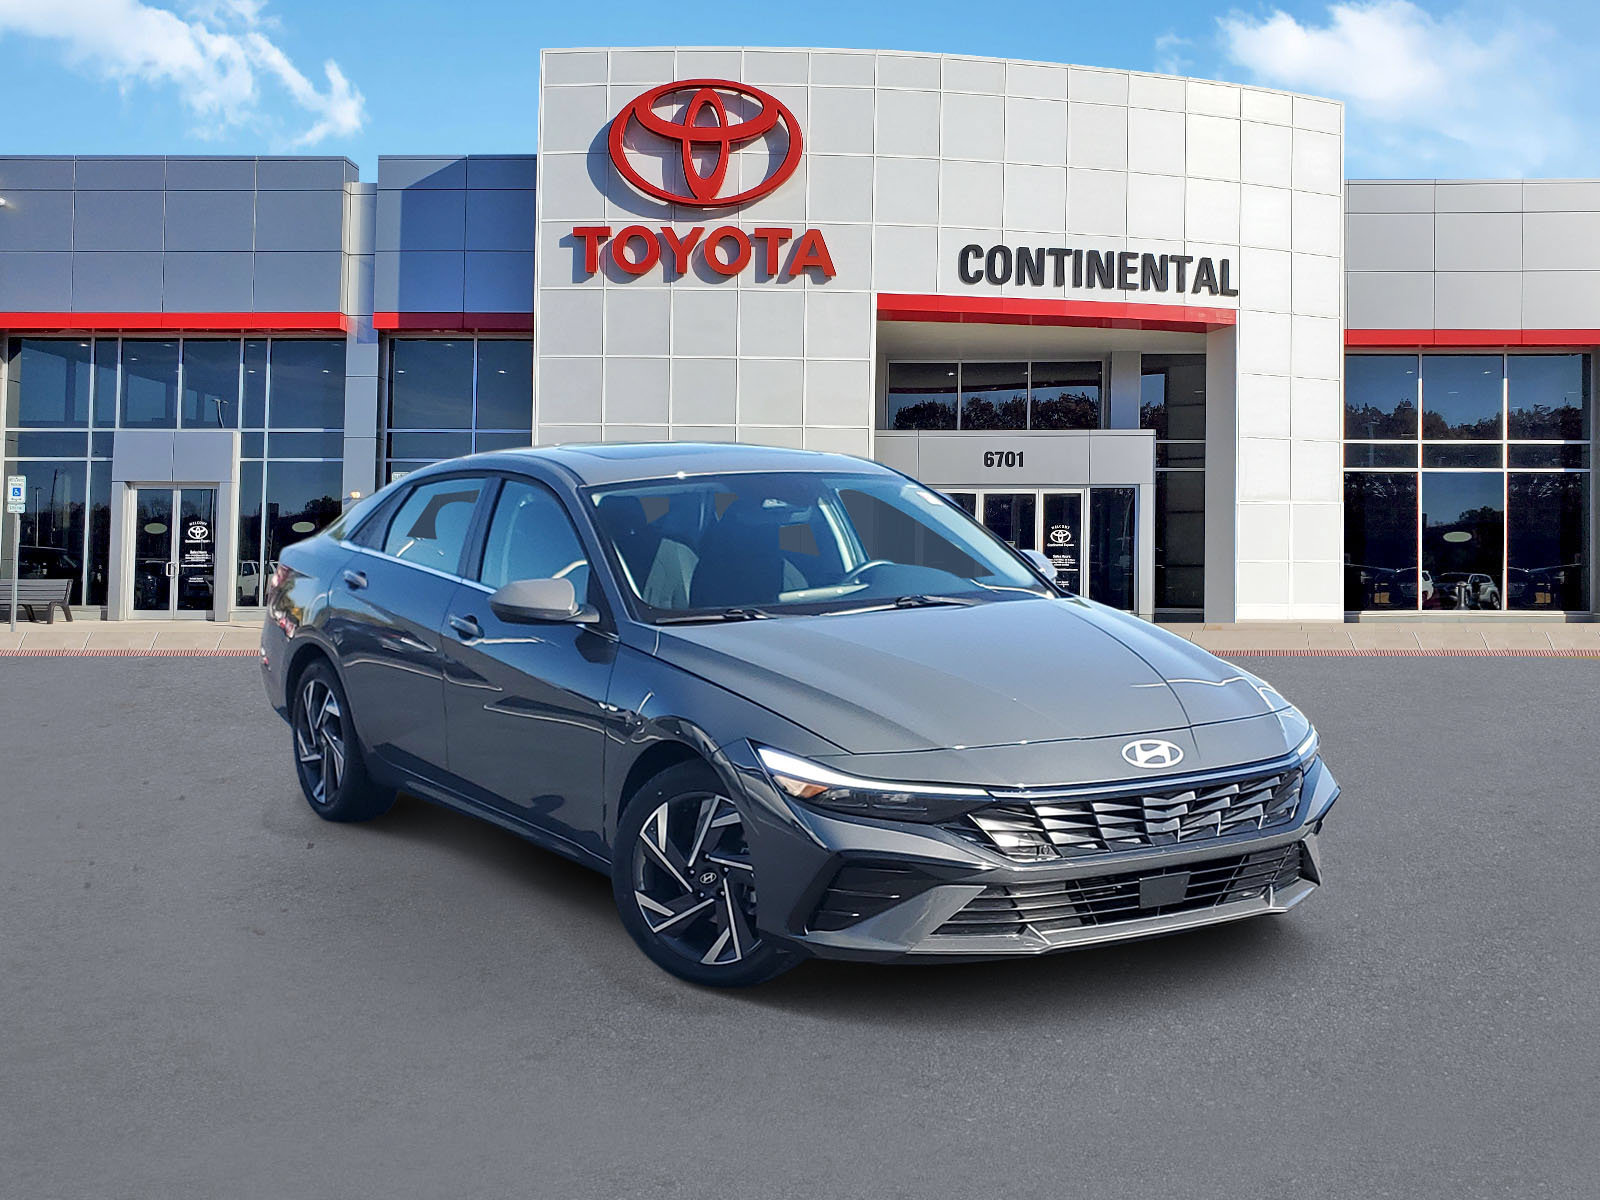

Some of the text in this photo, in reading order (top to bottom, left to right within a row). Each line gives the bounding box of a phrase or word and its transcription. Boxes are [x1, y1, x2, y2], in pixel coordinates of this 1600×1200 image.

[572, 225, 837, 277] TOYOTA
[958, 244, 1239, 297] CONTINENTAL
[983, 451, 1024, 468] 6701
